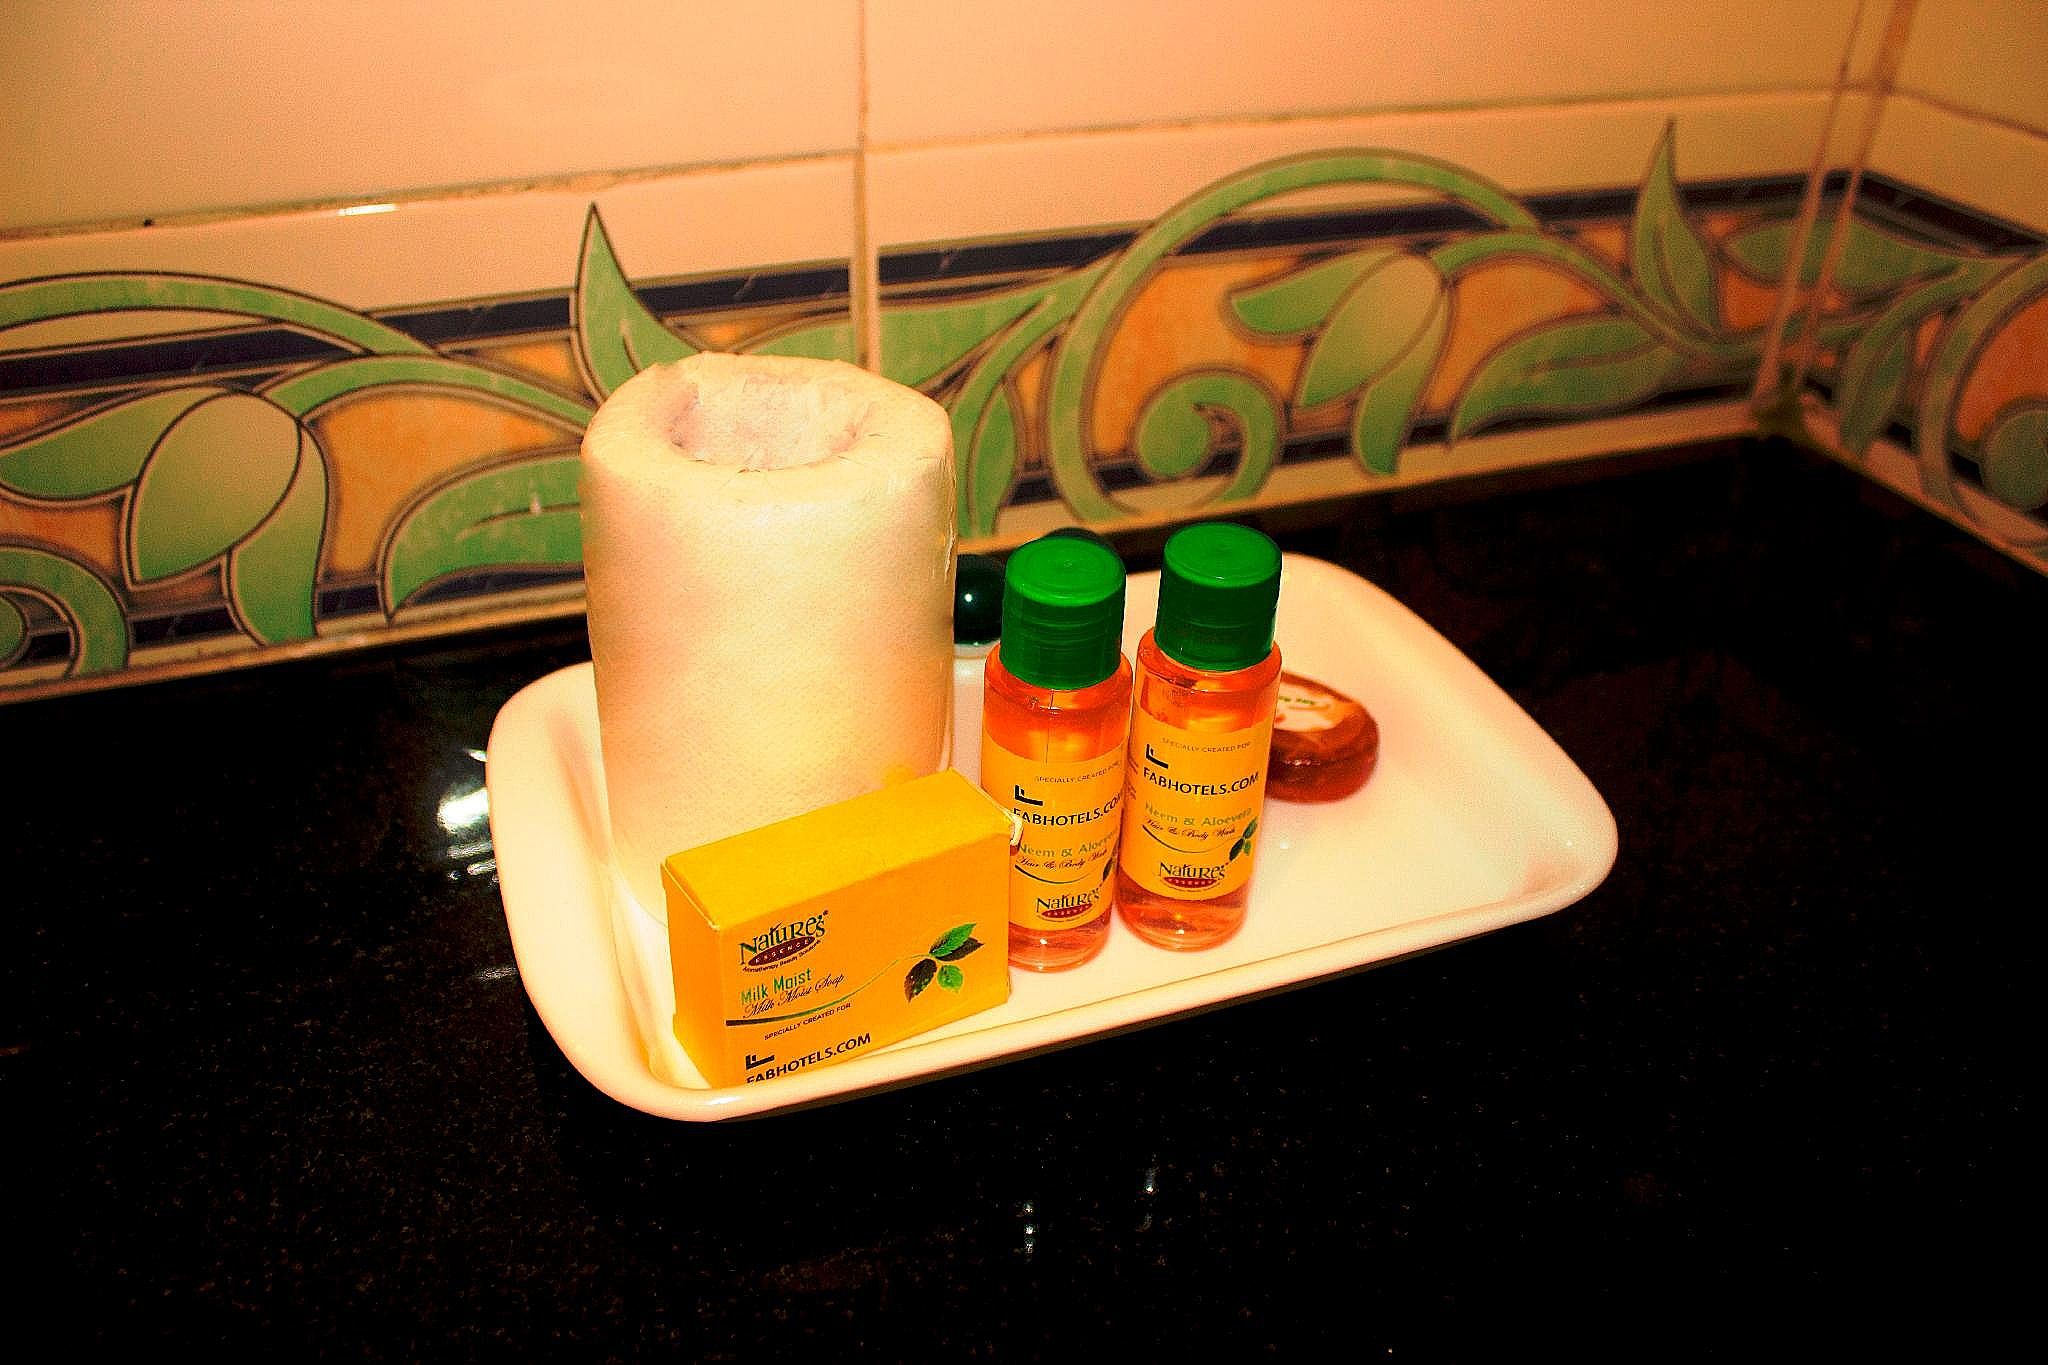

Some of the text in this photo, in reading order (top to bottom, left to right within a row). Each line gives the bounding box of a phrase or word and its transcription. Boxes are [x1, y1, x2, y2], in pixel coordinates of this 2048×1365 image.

[1143, 766, 1259, 796] FABHOTELS.COM
[1183, 817, 1195, 826] &
[1061, 848, 1073, 857] &
[741, 967, 812, 1005] Milk Moist
[742, 973, 845, 1019] Milk Moist Soap
[764, 1003, 852, 1041] SPECIALLY CREATED FOR
[746, 1033, 872, 1084] FABHOTELS.COM
